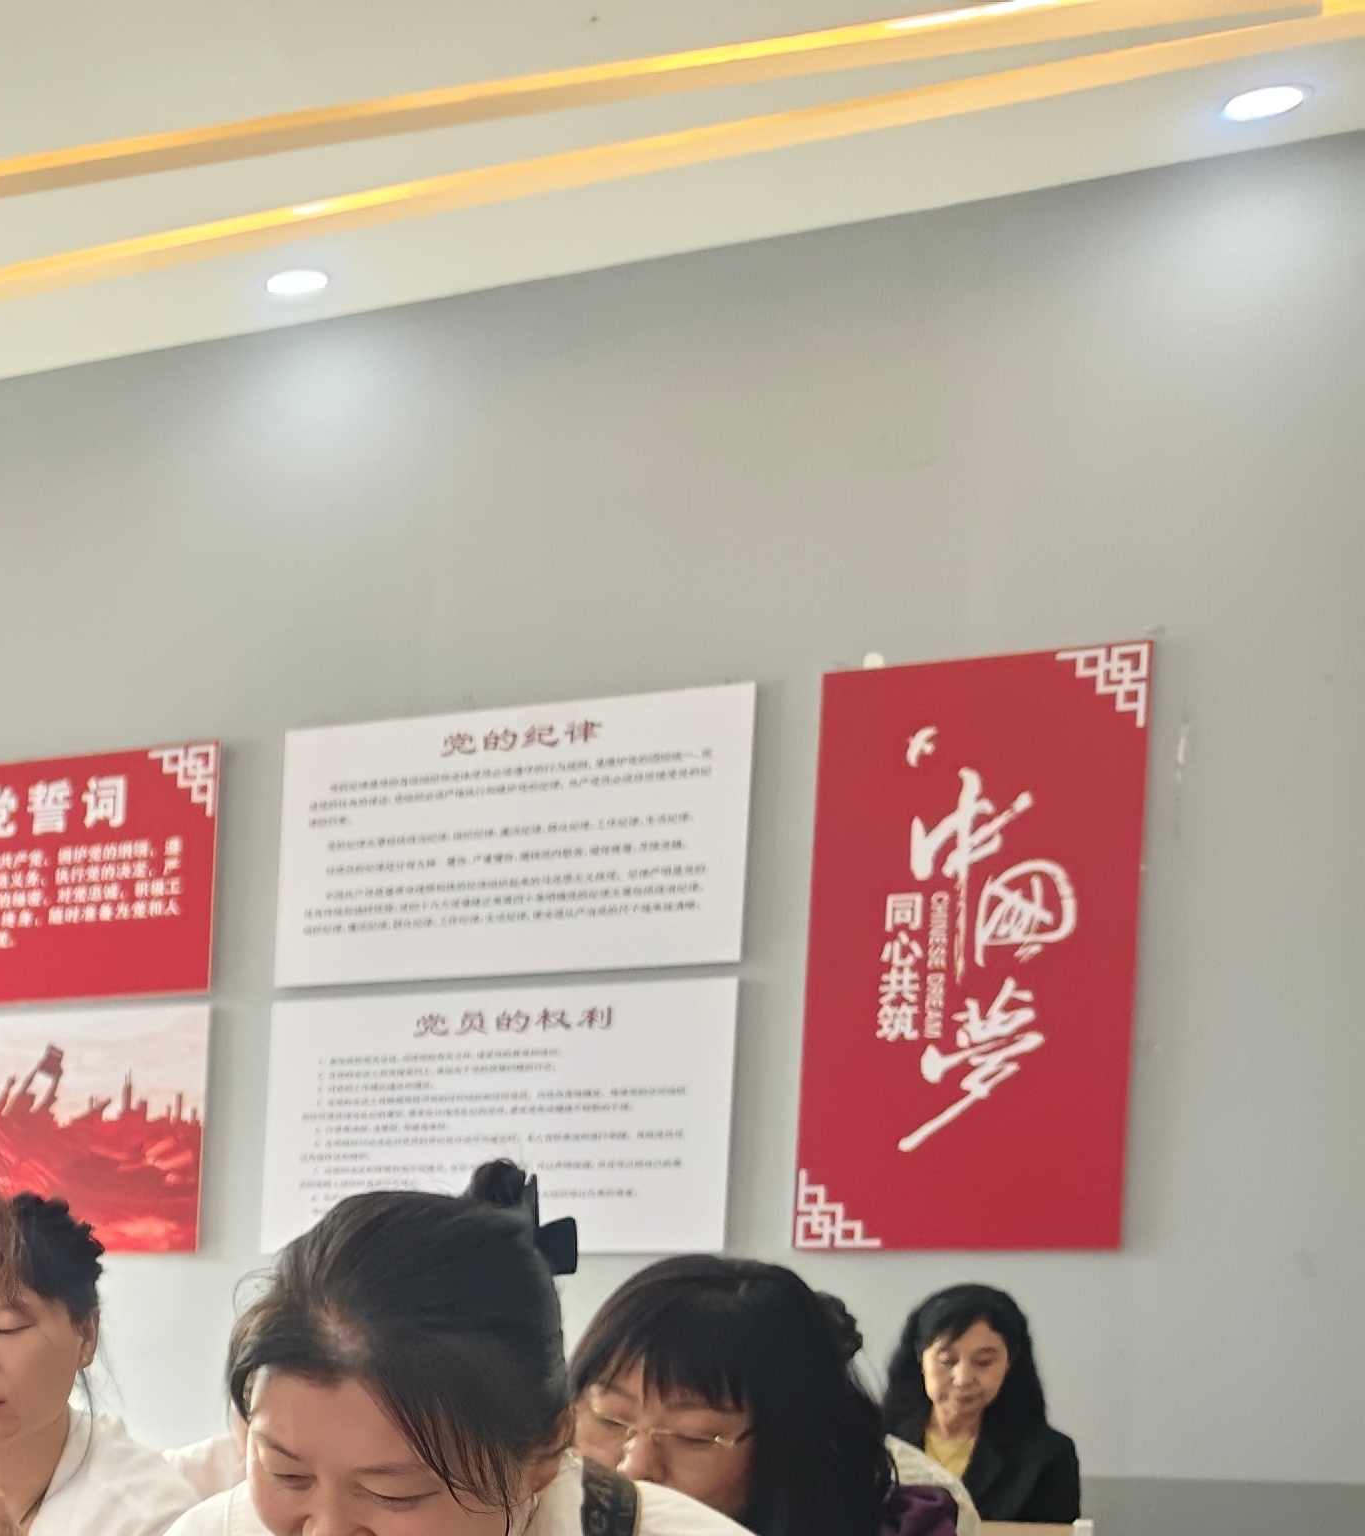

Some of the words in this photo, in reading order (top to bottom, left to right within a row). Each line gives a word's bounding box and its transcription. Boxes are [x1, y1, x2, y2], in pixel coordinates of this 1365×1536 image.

[440, 719, 603, 757] 党的纪律
[926, 890, 951, 970] CHINESE
[876, 892, 924, 1042] 同心共筑
[413, 1005, 615, 1038] 党员的权利
[923, 972, 946, 1039] DREAM
